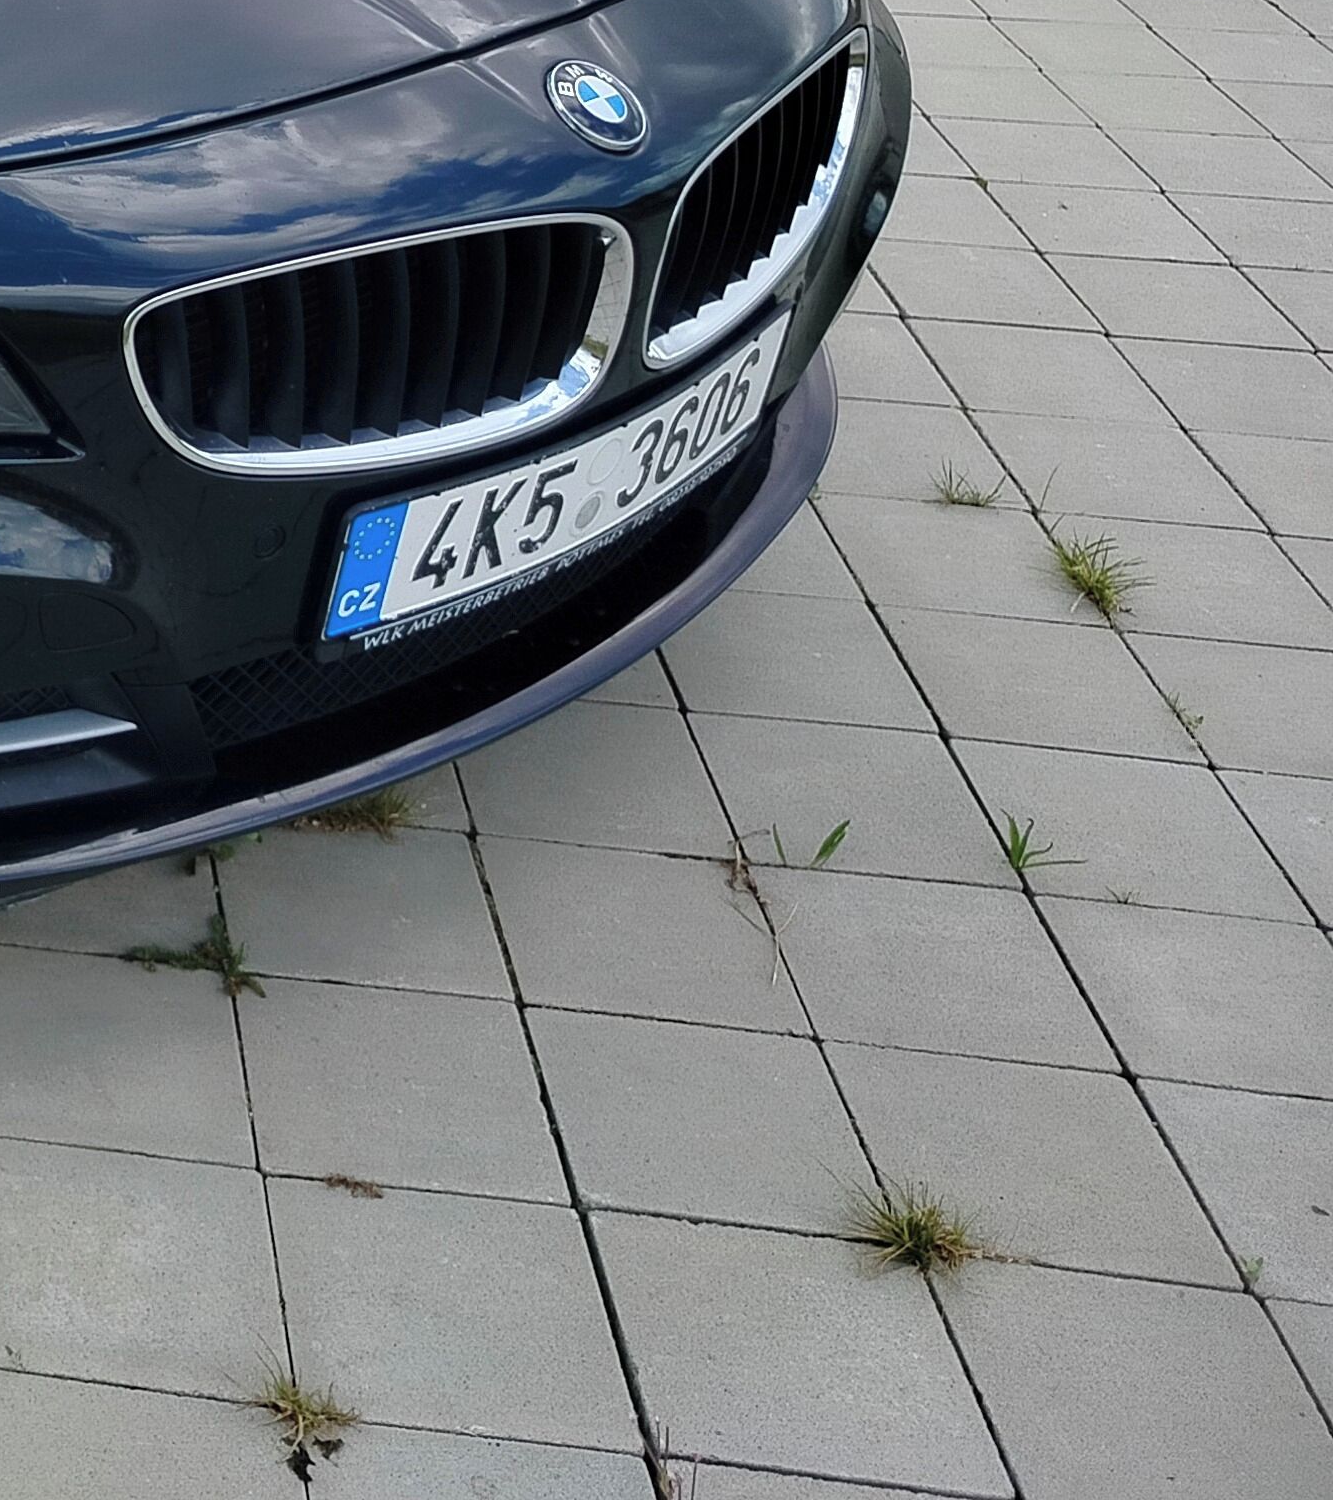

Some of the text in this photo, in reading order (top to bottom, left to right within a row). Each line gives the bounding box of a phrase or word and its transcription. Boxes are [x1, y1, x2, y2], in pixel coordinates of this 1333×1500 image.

[558, 64, 614, 97] BMW
[411, 458, 579, 589] 4K5
[616, 348, 761, 508] 3606
[338, 582, 381, 618] CZ
[364, 624, 405, 650] WLK
[407, 566, 550, 636] MEISTERBETRIEB
